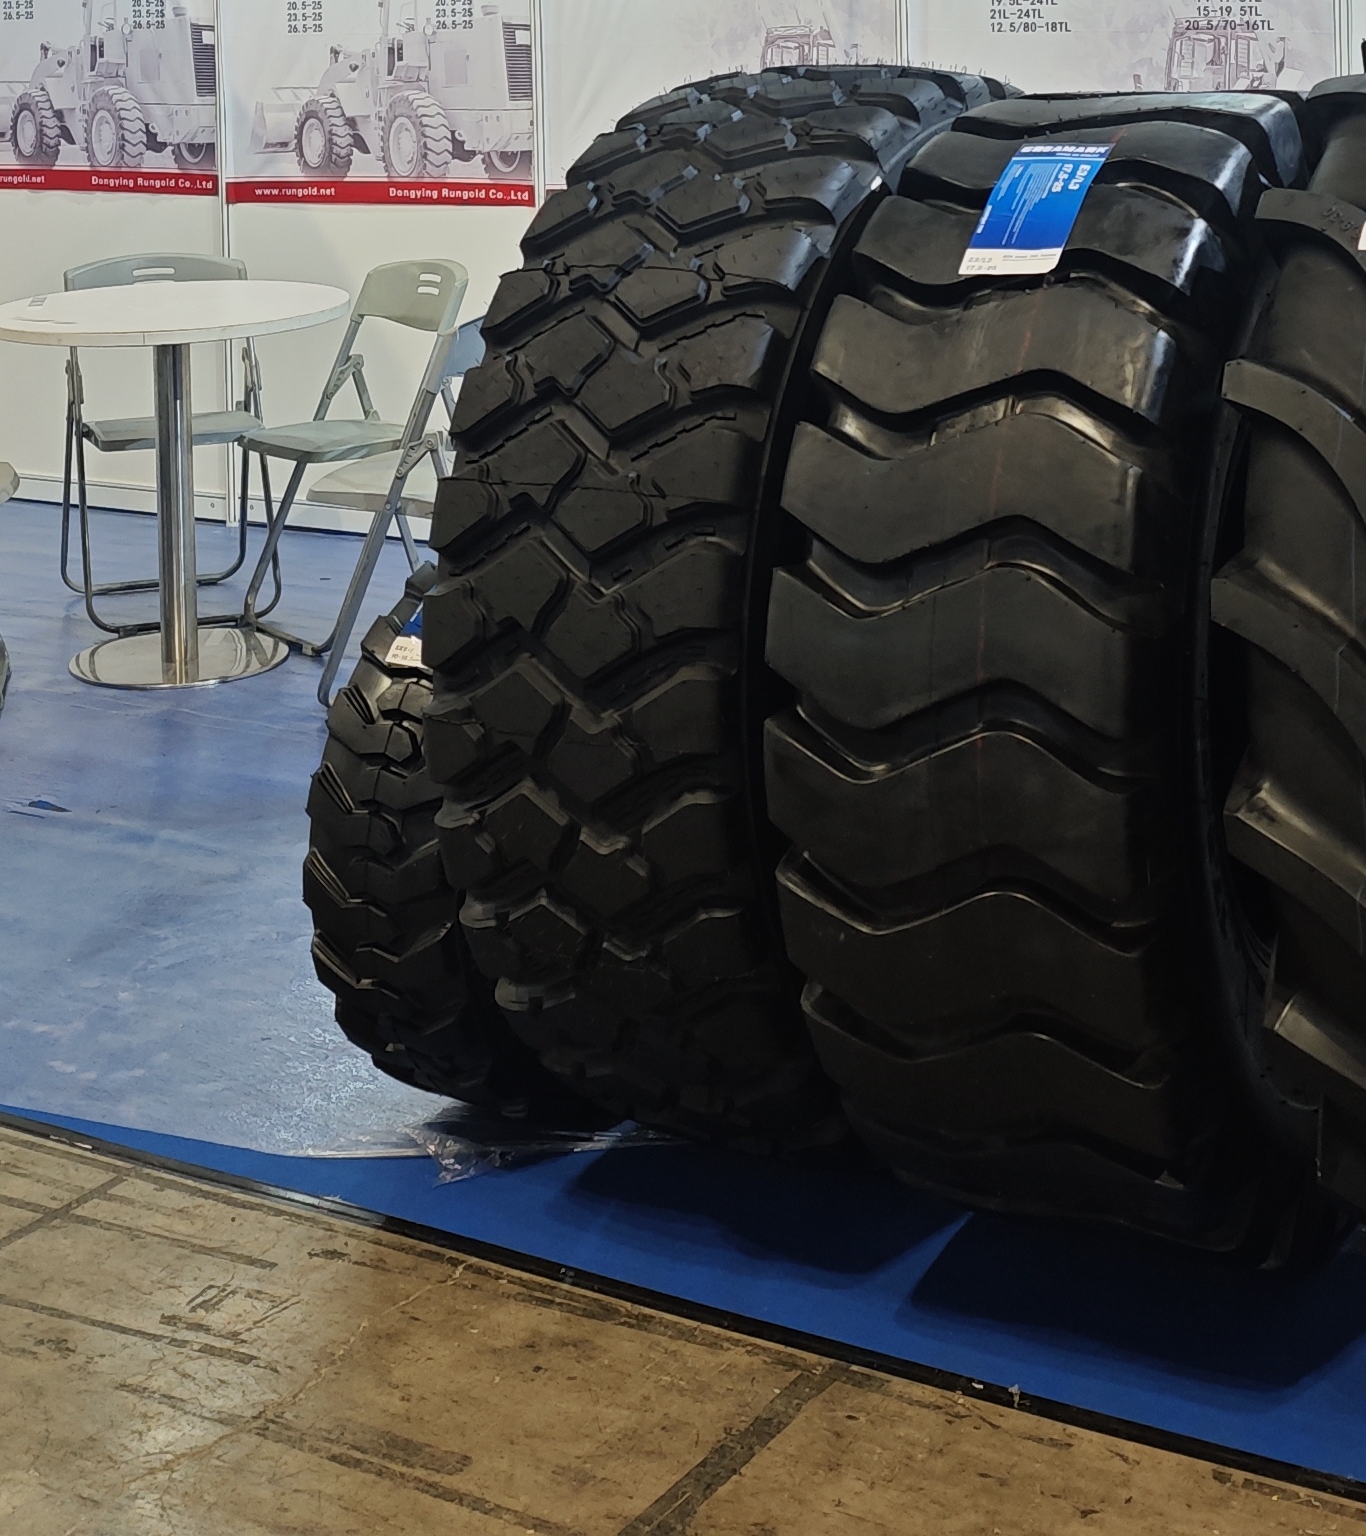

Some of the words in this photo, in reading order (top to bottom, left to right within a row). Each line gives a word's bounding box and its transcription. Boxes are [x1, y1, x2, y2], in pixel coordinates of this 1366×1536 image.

[989, 9, 1044, 19] 21L-24TL
[92, 176, 133, 188] Dongying
[137, 178, 175, 188] Rungold
[255, 187, 335, 197] www.rungold.net
[389, 188, 438, 199] Dongying
[442, 189, 485, 199] Rungold
